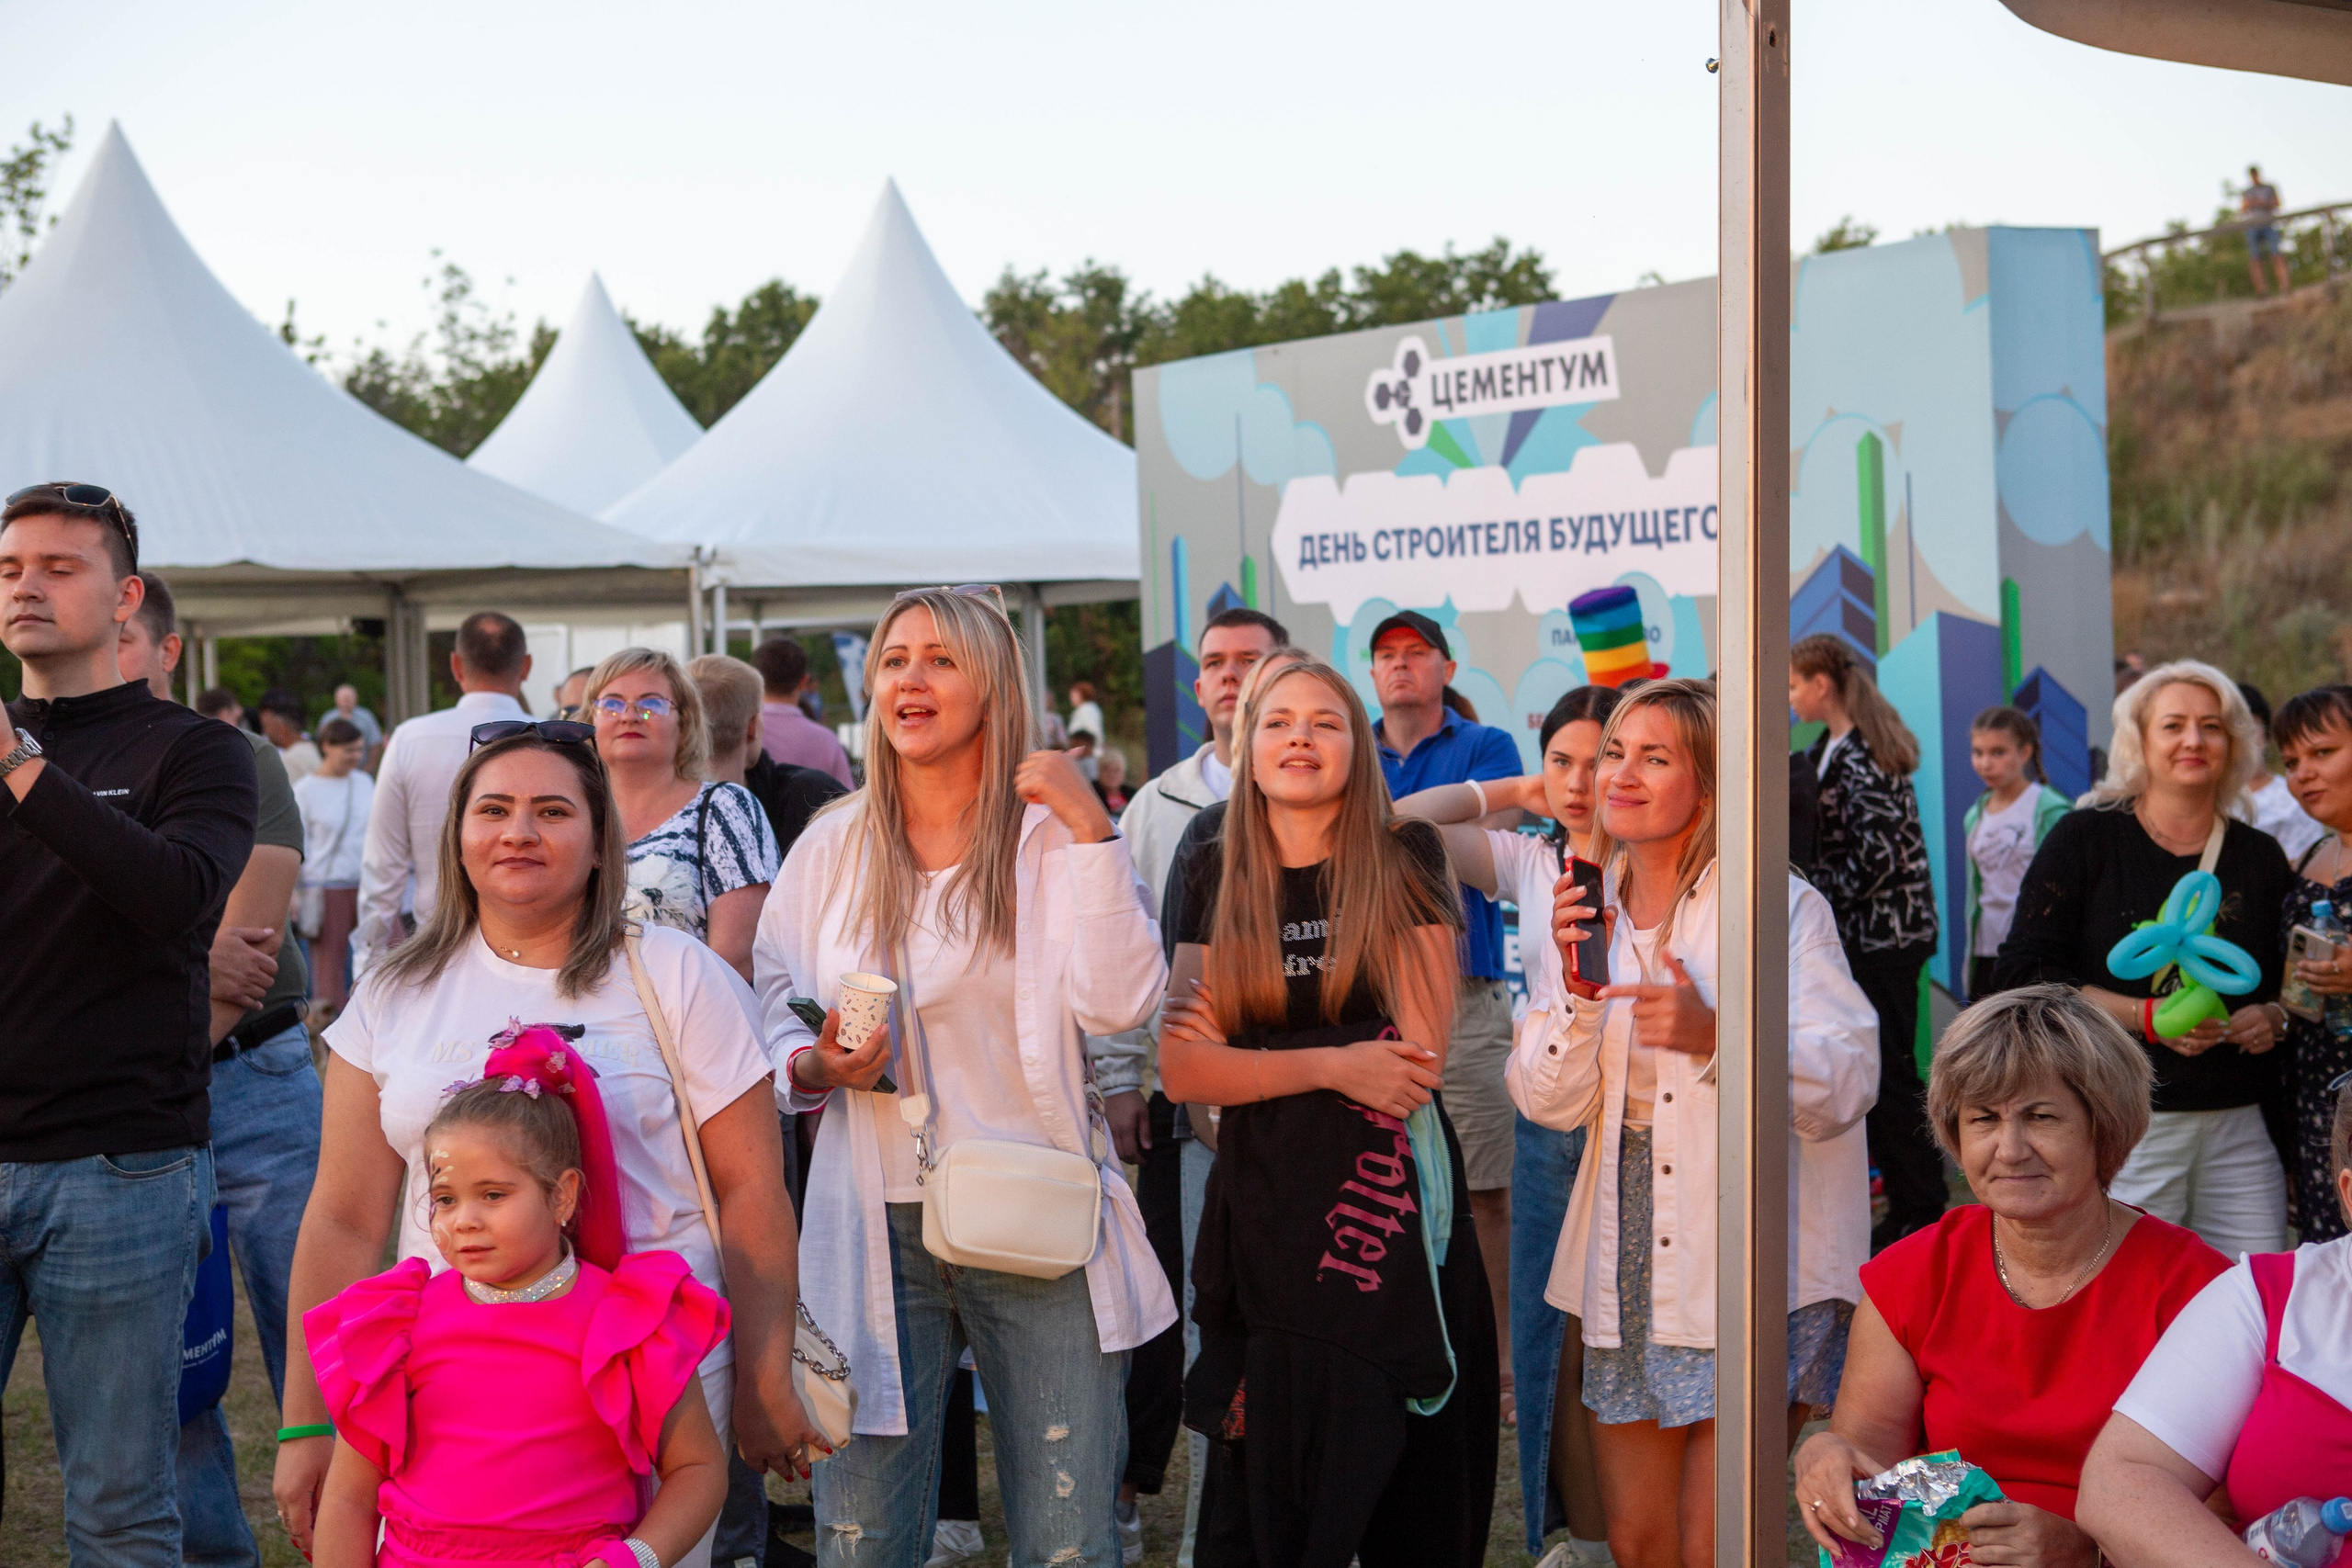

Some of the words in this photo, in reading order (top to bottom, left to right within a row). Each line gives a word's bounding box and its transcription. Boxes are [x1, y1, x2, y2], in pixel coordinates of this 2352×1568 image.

[1431, 350, 1608, 412] ЦЕМЕНТУМ
[1299, 531, 1367, 570] ДЕНЬ
[1373, 518, 1541, 561] СТРОИТЕЛЯ
[1549, 504, 1718, 554] БУДУЩЕГО
[573, 1039, 641, 1068] MER
[183, 1327, 227, 1360] МЕНТУМ
